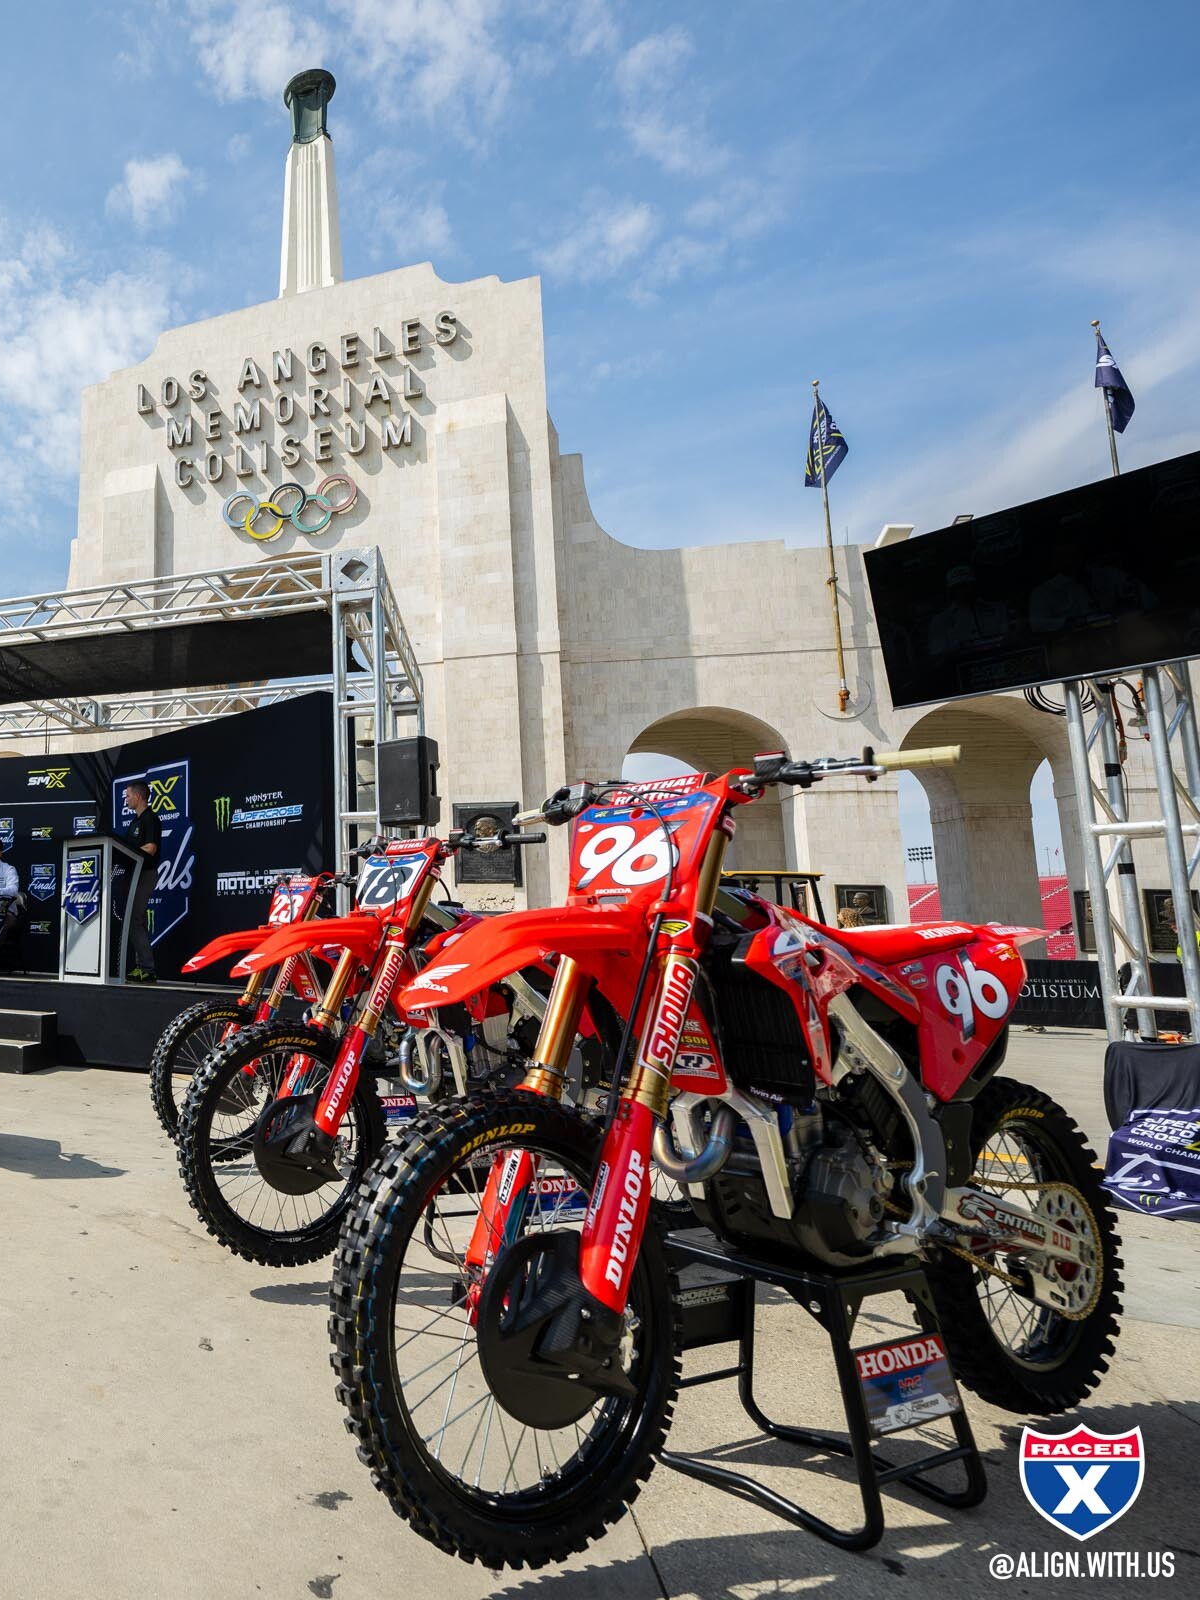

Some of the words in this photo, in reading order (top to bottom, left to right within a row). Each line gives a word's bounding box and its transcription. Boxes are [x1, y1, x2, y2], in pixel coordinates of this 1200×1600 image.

[137, 369, 208, 415] LOS
[237, 310, 457, 392] ANGELES
[166, 364, 423, 449] MEMORIAL
[174, 411, 414, 488] COLISEUM
[27, 772, 68, 788] SMX
[245, 791, 284, 804] MONSTER
[232, 804, 303, 823] SUPERCROSS
[245, 819, 286, 829] CHAMPIONSHIP
[389, 842, 424, 850] RENTHAL
[577, 820, 679, 890] 96
[28, 877, 56, 891] Finals
[61, 880, 100, 906] Finals
[358, 866, 413, 905] 18
[269, 895, 304, 923] 23
[374, 953, 400, 1009] SHOWA
[1019, 984, 1100, 998] OLISEUM
[935, 951, 1008, 1043] 96
[206, 1011, 238, 1019] DUNLOP
[649, 963, 695, 1068] SHOWA
[269, 1036, 318, 1046] DUNLOP
[324, 1051, 357, 1123] DUNLOP
[750, 1086, 769, 1098] Twin
[770, 1094, 783, 1102] Air
[381, 1097, 416, 1107] ONDA
[460, 1123, 537, 1154] DUNLOP
[1131, 1128, 1194, 1146] CROSS
[1138, 1122, 1195, 1138] MOTO
[1128, 1138, 1162, 1150] WORLD
[605, 1150, 646, 1290] DUNLOP
[856, 1339, 944, 1378] HONDA
